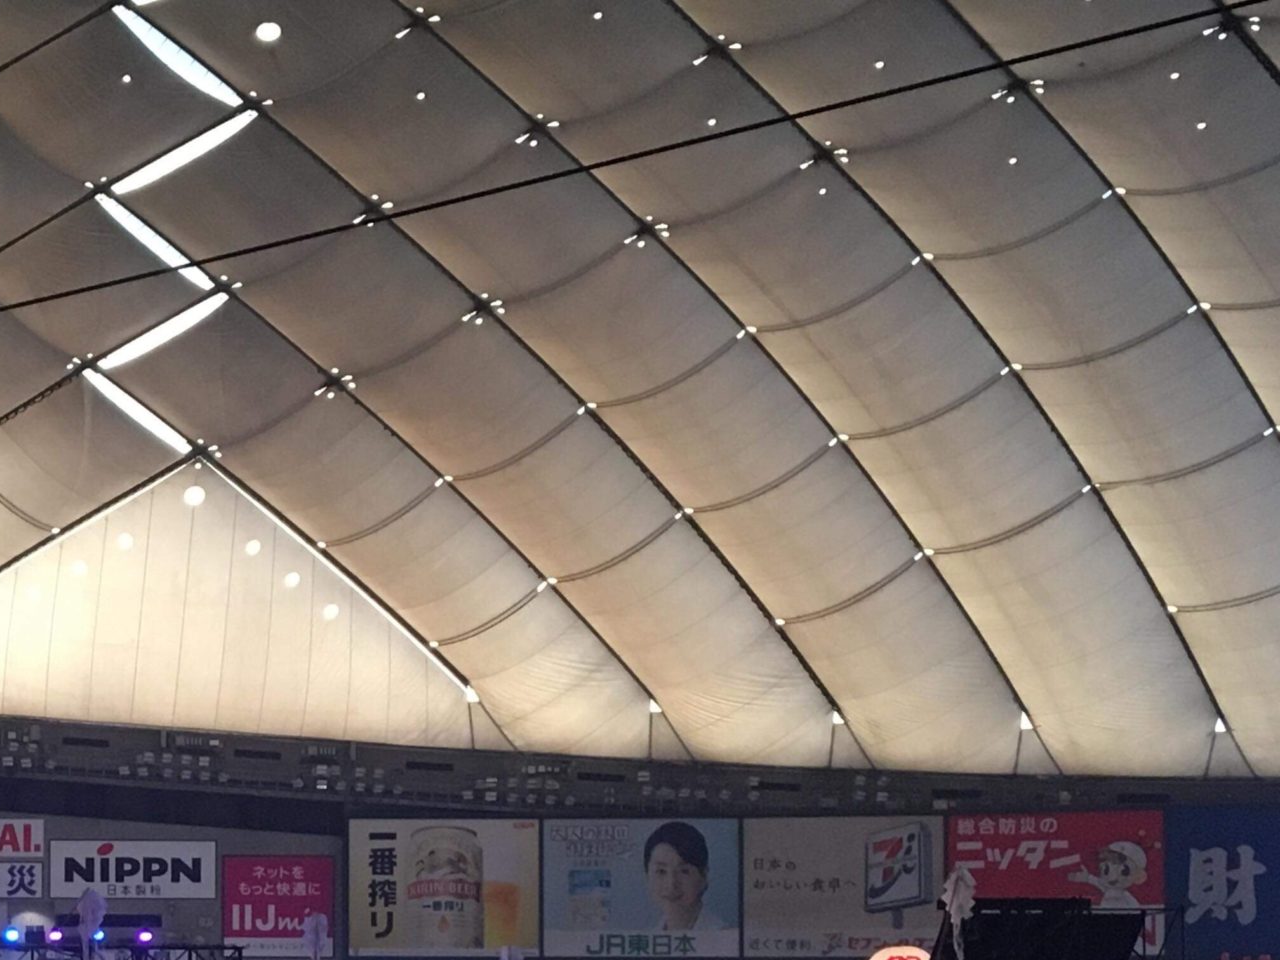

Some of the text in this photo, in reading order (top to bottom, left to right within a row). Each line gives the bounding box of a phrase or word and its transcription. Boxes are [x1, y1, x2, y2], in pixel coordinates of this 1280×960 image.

[957, 818, 1058, 836] 総合防災の
[955, 840, 1081, 870] ニッタン
[252, 865, 304, 879] ネットを
[107, 884, 161, 896] 日本製粉
[238, 882, 321, 896] もっと快適に
[368, 832, 398, 939] 一番搾り
[1183, 844, 1267, 926] 財
[586, 934, 697, 956] JR東日本
